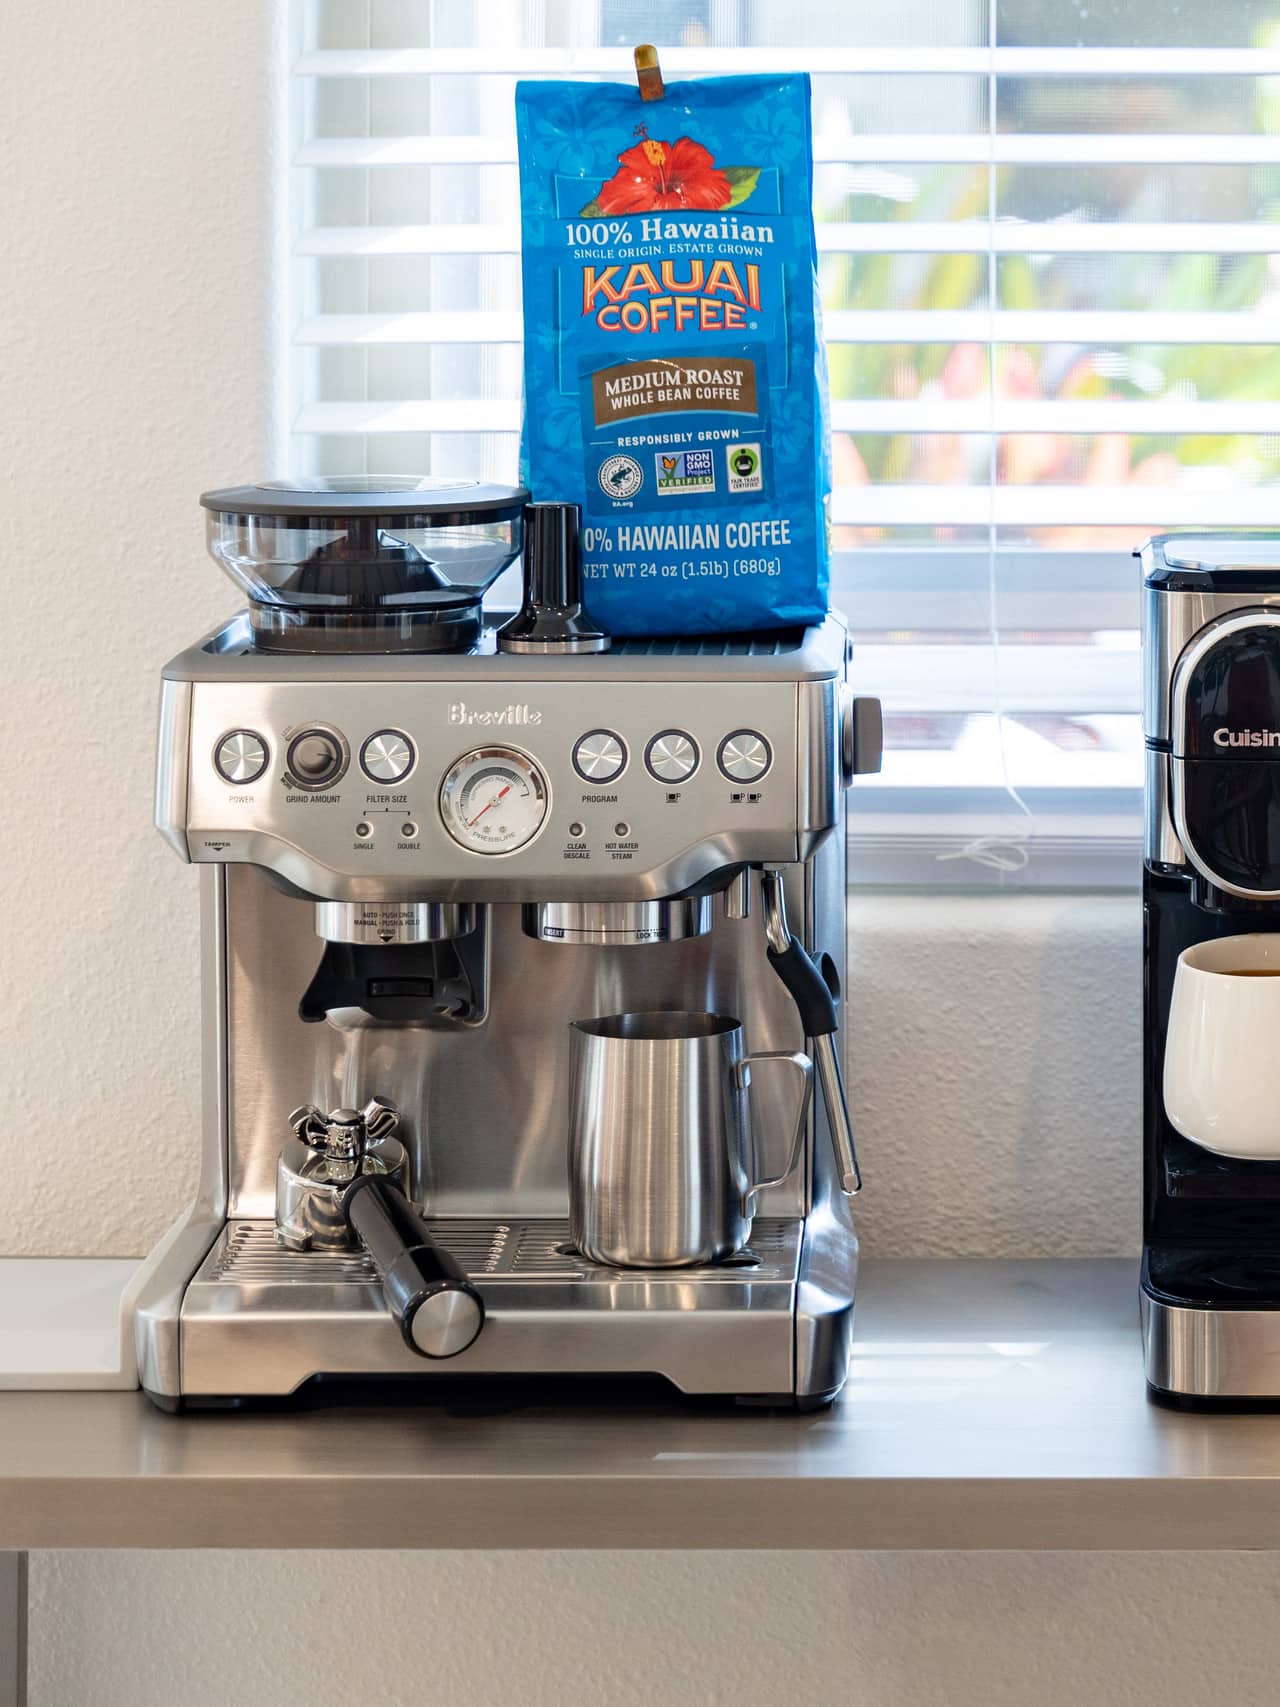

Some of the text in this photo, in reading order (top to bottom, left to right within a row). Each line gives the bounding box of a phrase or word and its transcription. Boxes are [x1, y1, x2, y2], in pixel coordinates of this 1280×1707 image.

[566, 217, 774, 247] 100% Hawaiian
[574, 248, 614, 260] SINGLE
[669, 243, 714, 254] ESTATE
[718, 244, 763, 256] GROWN
[582, 259, 762, 317] KAUAI
[596, 296, 750, 334] COFFEE
[605, 368, 744, 398] MEDIUM ROAST
[611, 388, 740, 411] WHOLE BEAN COFFEE
[617, 428, 740, 448] RESPONSIBLY GROWN
[686, 452, 710, 462] NON
[687, 461, 710, 470] GMO
[687, 468, 711, 476] Project
[660, 477, 712, 488] VERIFIED
[584, 520, 792, 552] 0% HAWAIIAN COFFEE
[614, 564, 636, 578] WT
[640, 563, 658, 577] 24
[662, 565, 678, 577] oz
[682, 560, 729, 580] (1.5lb)
[734, 558, 782, 576] (680g)
[448, 702, 542, 725] Breville
[229, 795, 254, 804] POWER
[286, 795, 341, 804] GRIND AMOUNT
[366, 795, 408, 804] FILTER SIZE
[582, 796, 618, 804] PROGRAM
